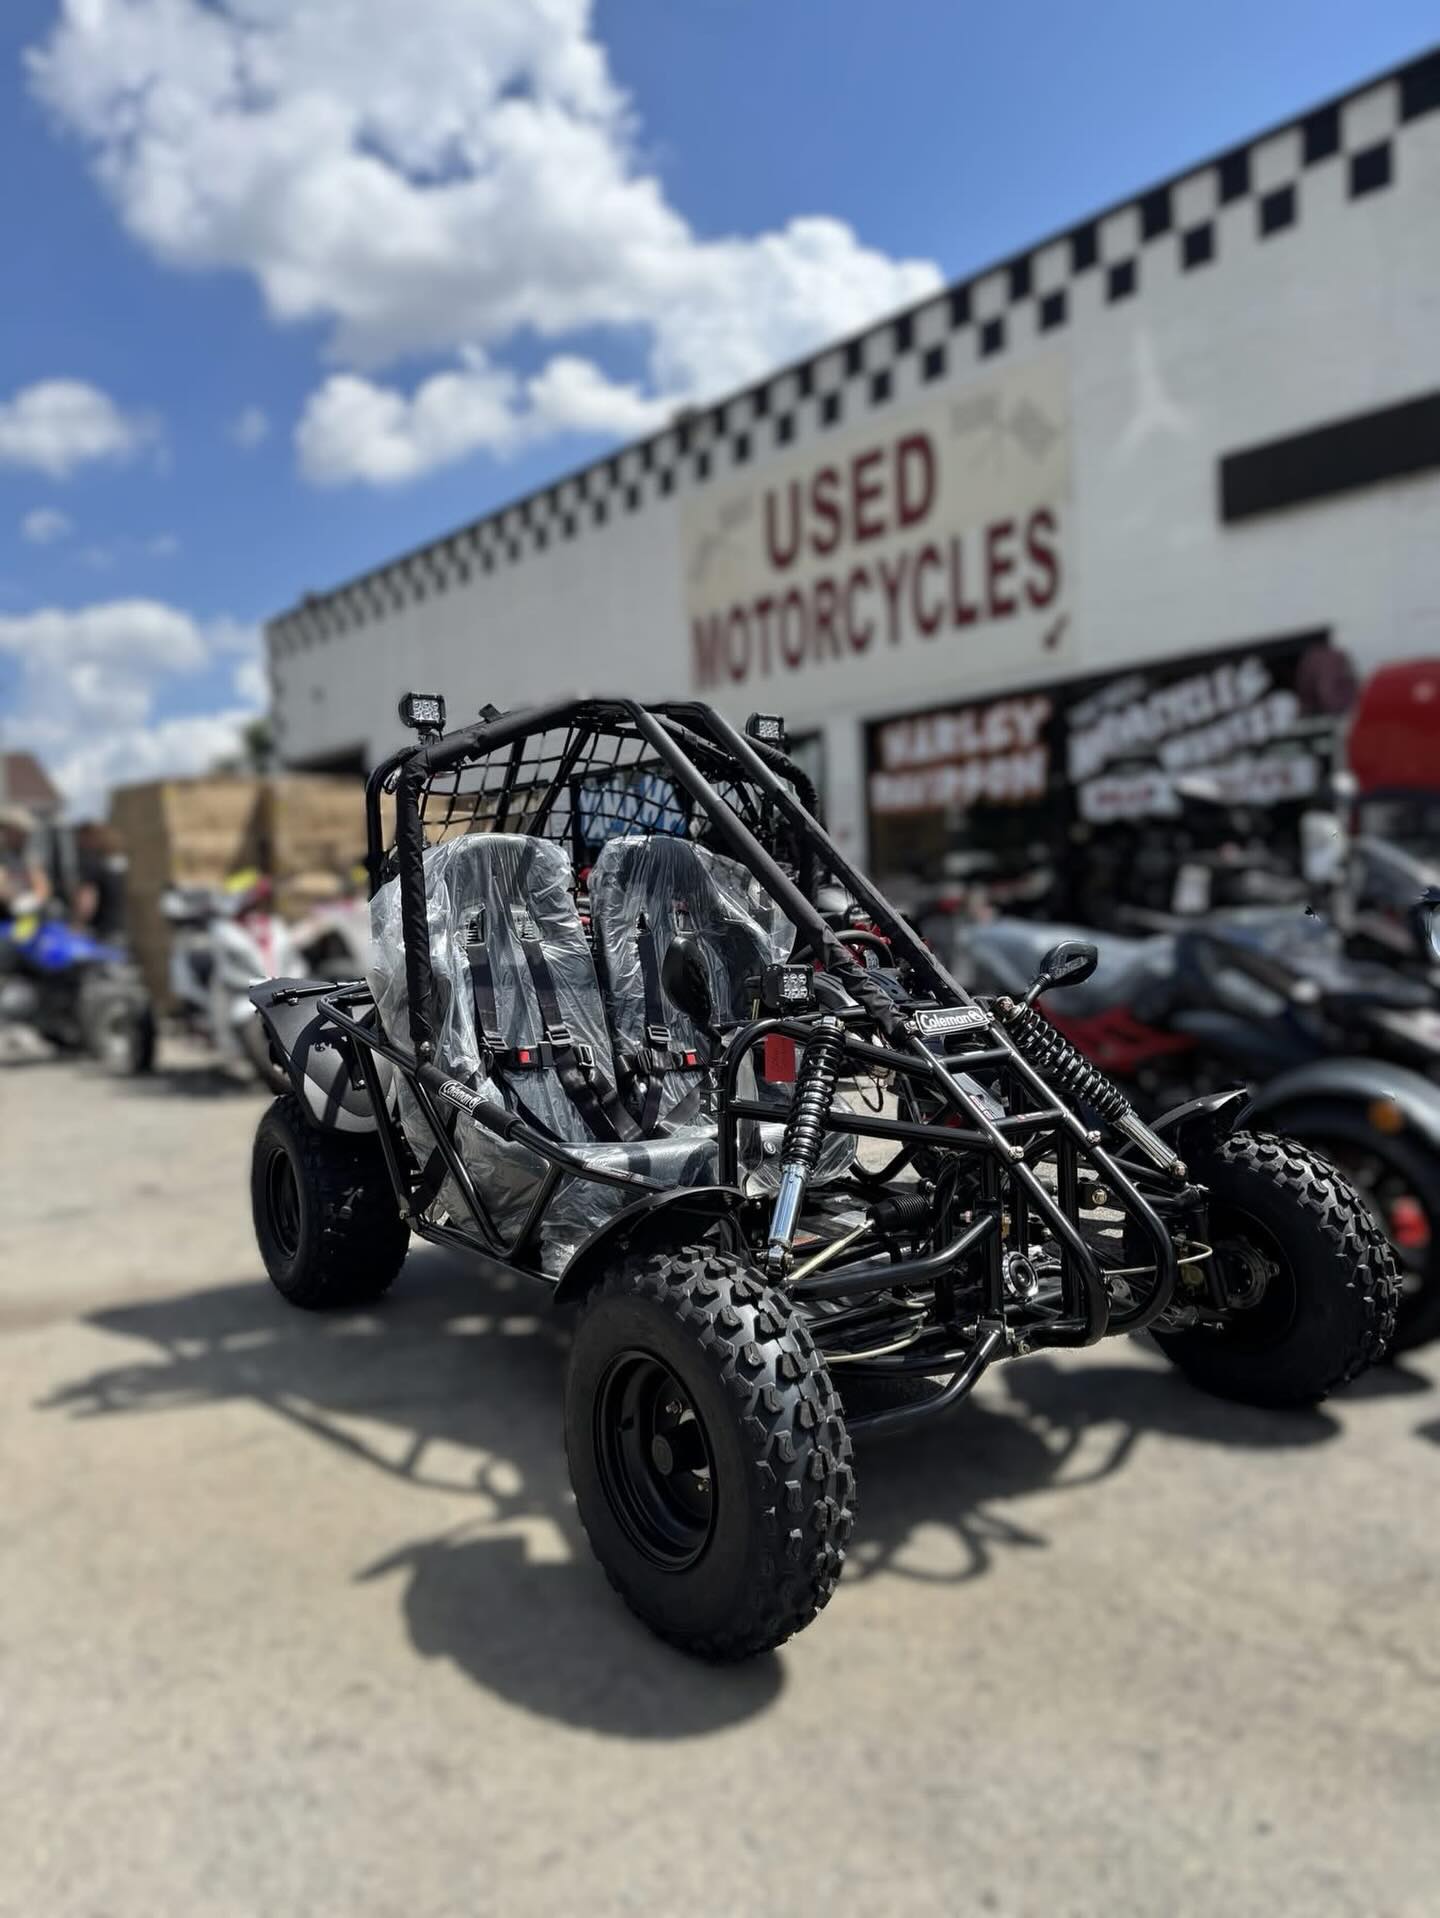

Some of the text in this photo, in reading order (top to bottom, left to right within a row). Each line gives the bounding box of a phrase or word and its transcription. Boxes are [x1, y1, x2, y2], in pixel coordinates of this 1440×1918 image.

[765, 433, 937, 571] USED
[692, 507, 1061, 693] MOTORCYCLES
[920, 1013, 972, 1029] Coleman
